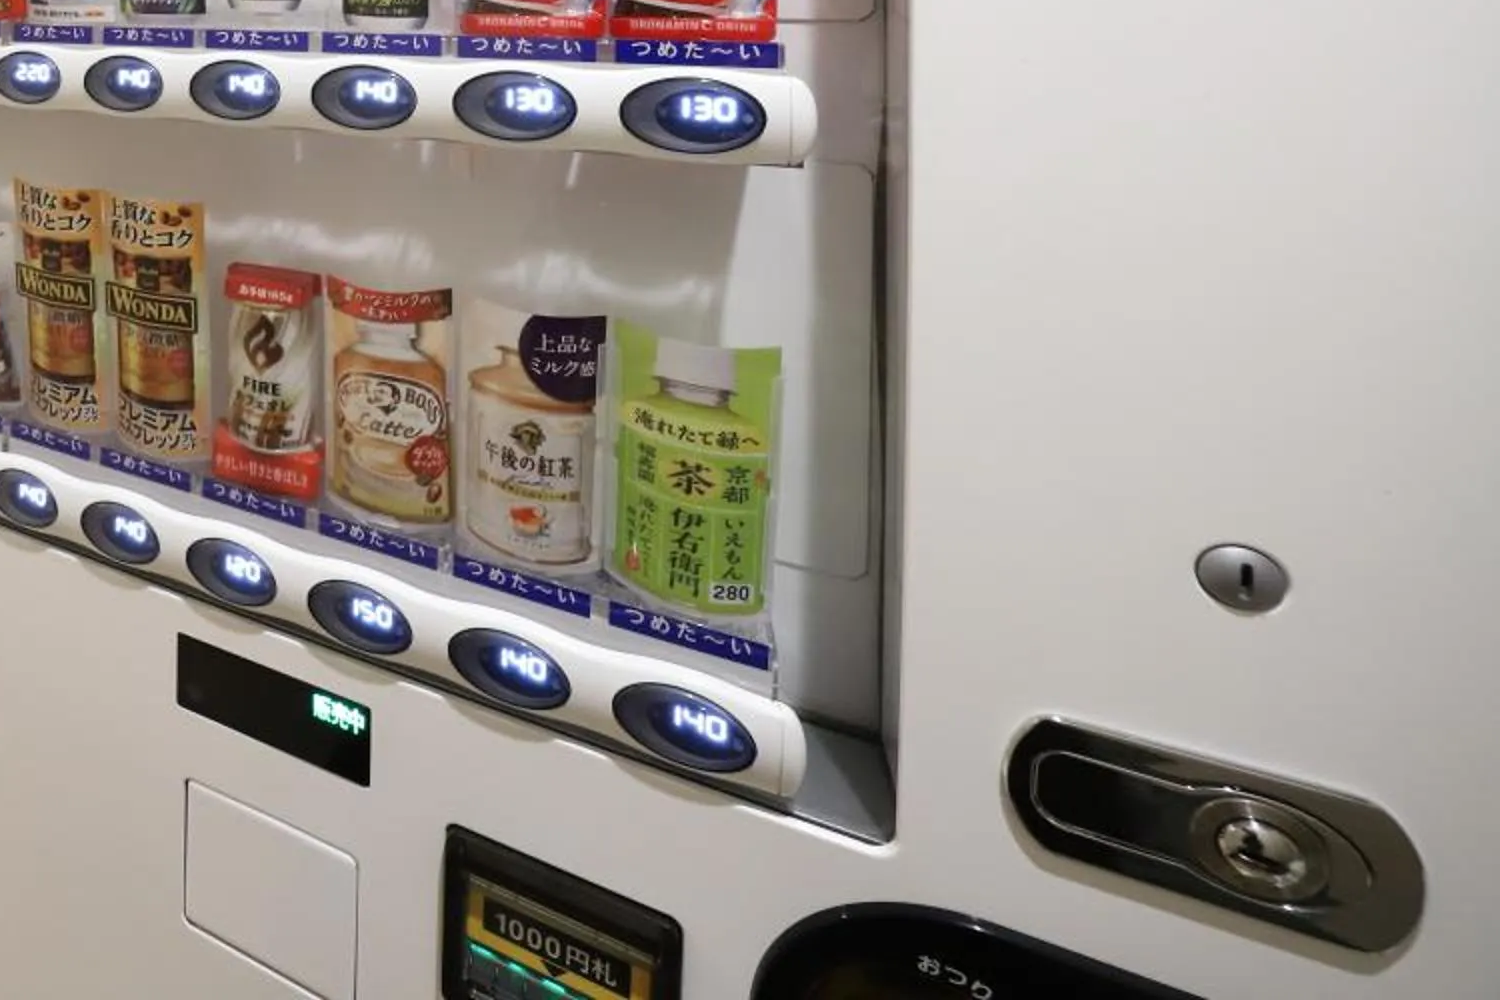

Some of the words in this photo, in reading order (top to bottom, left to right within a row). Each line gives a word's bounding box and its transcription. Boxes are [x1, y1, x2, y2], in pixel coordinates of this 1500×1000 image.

[356, 79, 398, 104] 140
[505, 88, 554, 113] 130
[680, 96, 738, 124] 130
[20, 183, 58, 211] 上質な
[111, 197, 157, 226] 上質な
[20, 201, 93, 233] 香りとコク
[110, 218, 195, 249] 香りとコク
[19, 266, 89, 304] WONDA
[110, 284, 189, 324] WONDA
[533, 332, 594, 354] 上品な
[530, 356, 597, 378] ミルク感
[242, 375, 282, 397] FIRE
[403, 386, 440, 426] BOSS
[359, 411, 424, 440] Latte
[484, 438, 575, 480] 午後の紅茶
[667, 458, 715, 497] 茶
[720, 465, 752, 506] 京都
[668, 506, 706, 599] 伊右衛門
[724, 517, 746, 581] いえもん
[711, 585, 750, 601] 280
[500, 647, 548, 683] 140
[672, 704, 729, 743] 140
[493, 911, 618, 988] 1000円札
[916, 953, 994, 1000] おつり
